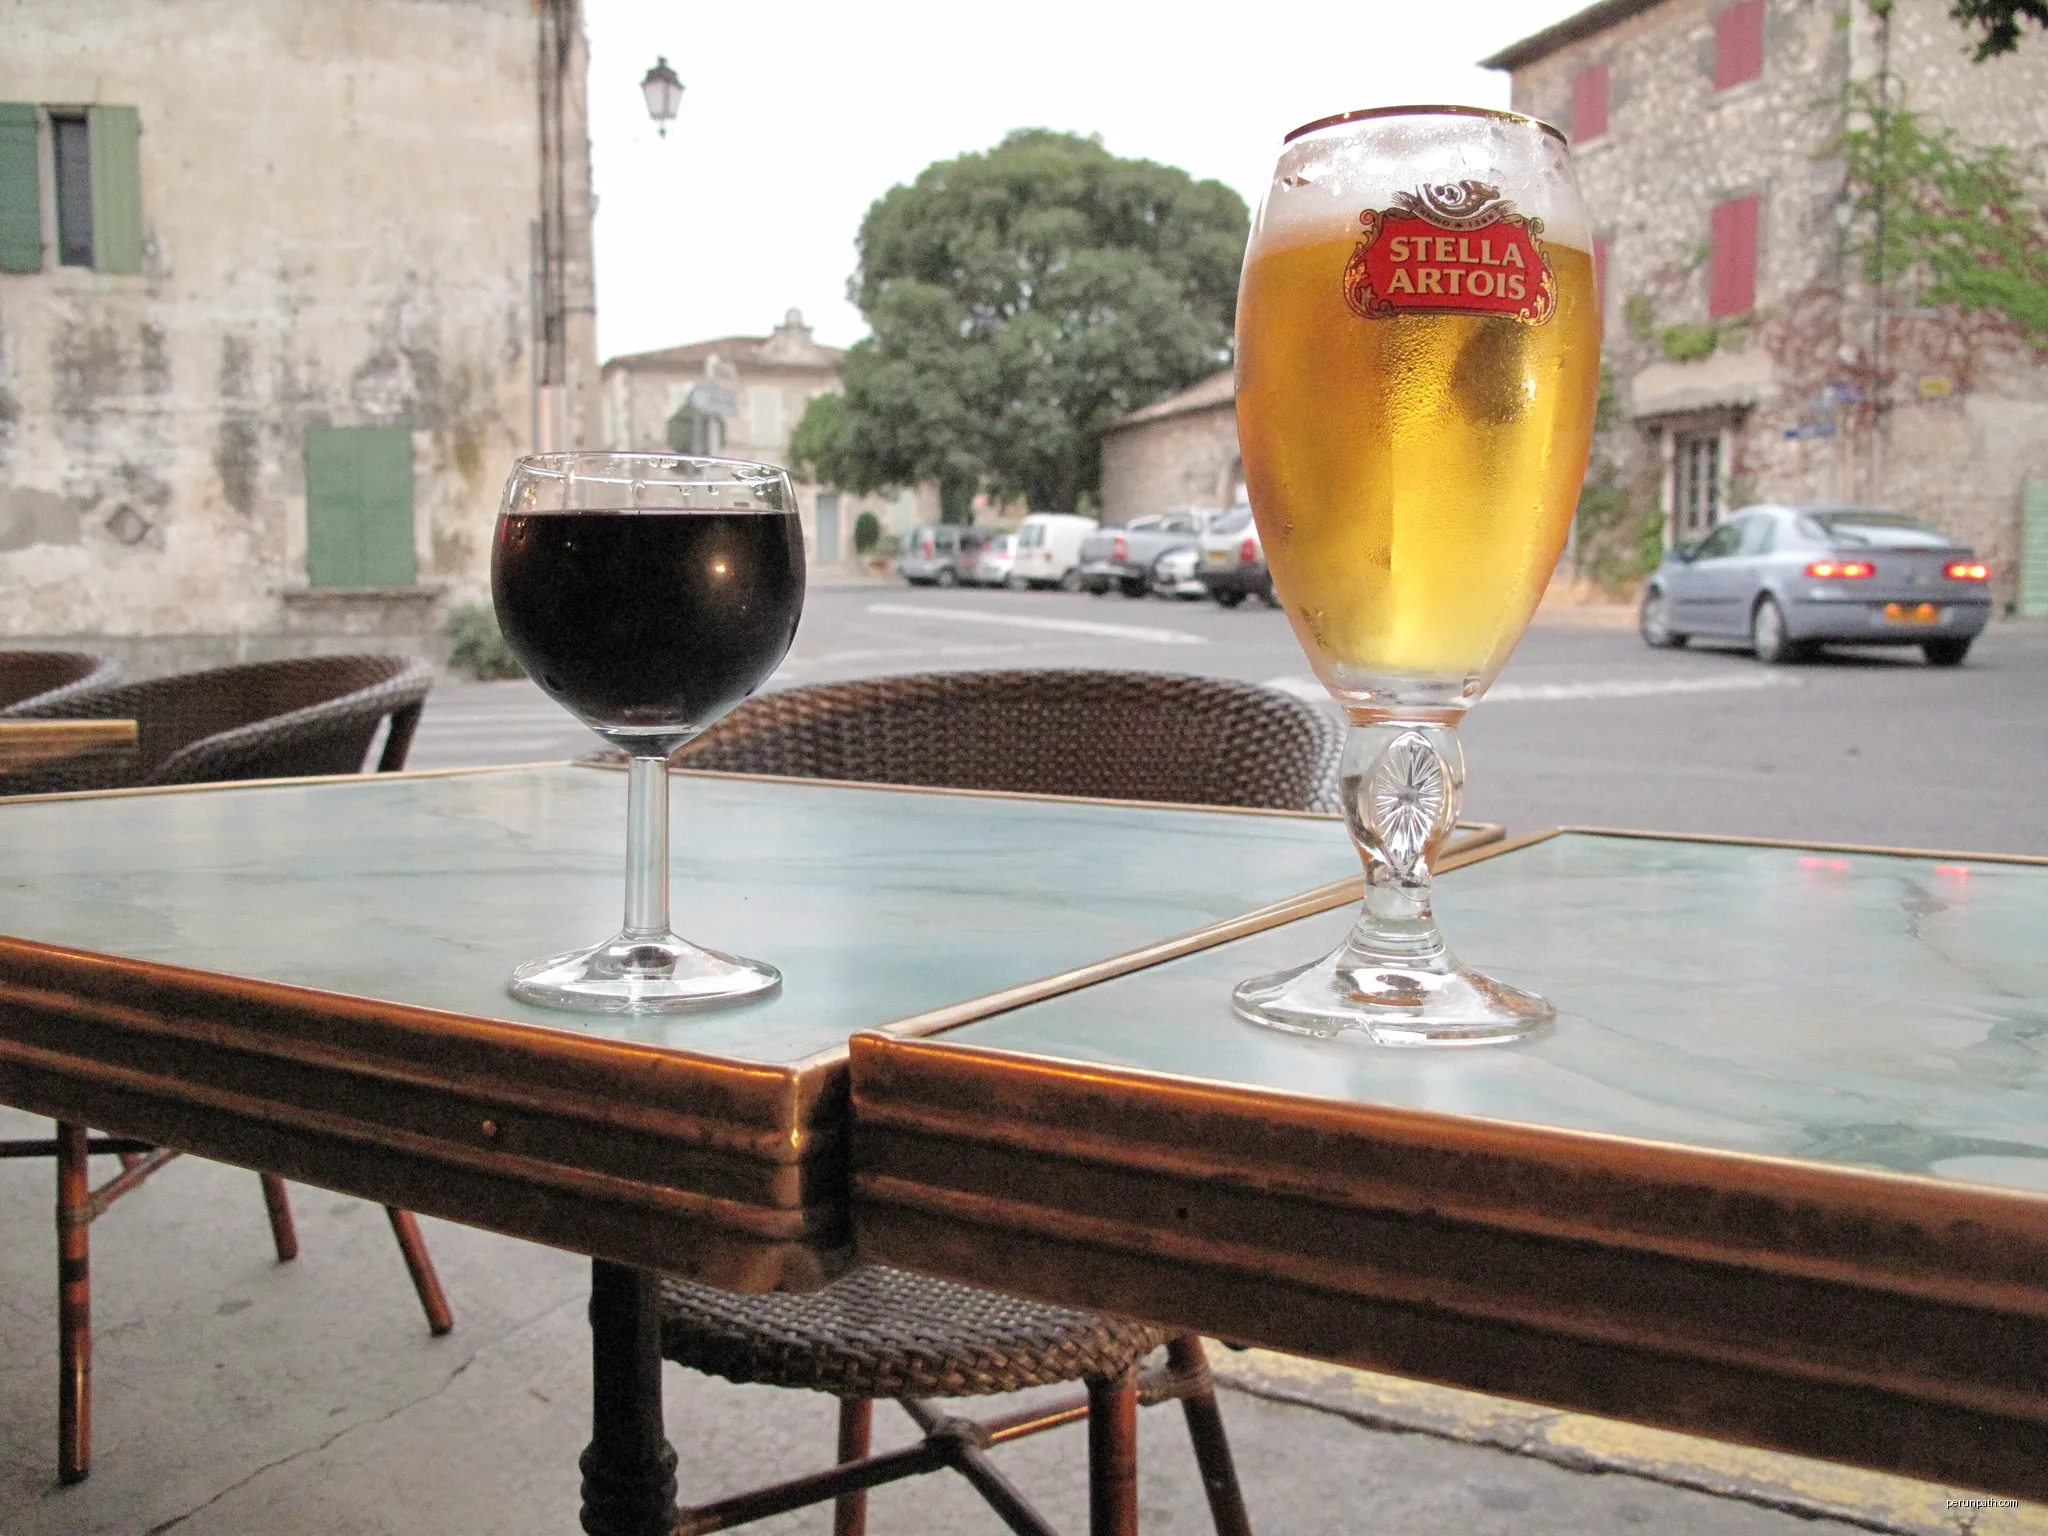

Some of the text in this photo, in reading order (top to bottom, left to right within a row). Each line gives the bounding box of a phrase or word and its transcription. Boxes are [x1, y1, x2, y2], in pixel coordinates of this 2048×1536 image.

[1418, 208, 1451, 228] ANNO
[1389, 236, 1526, 269] STELLA
[1386, 268, 1527, 301] ARTOIS
